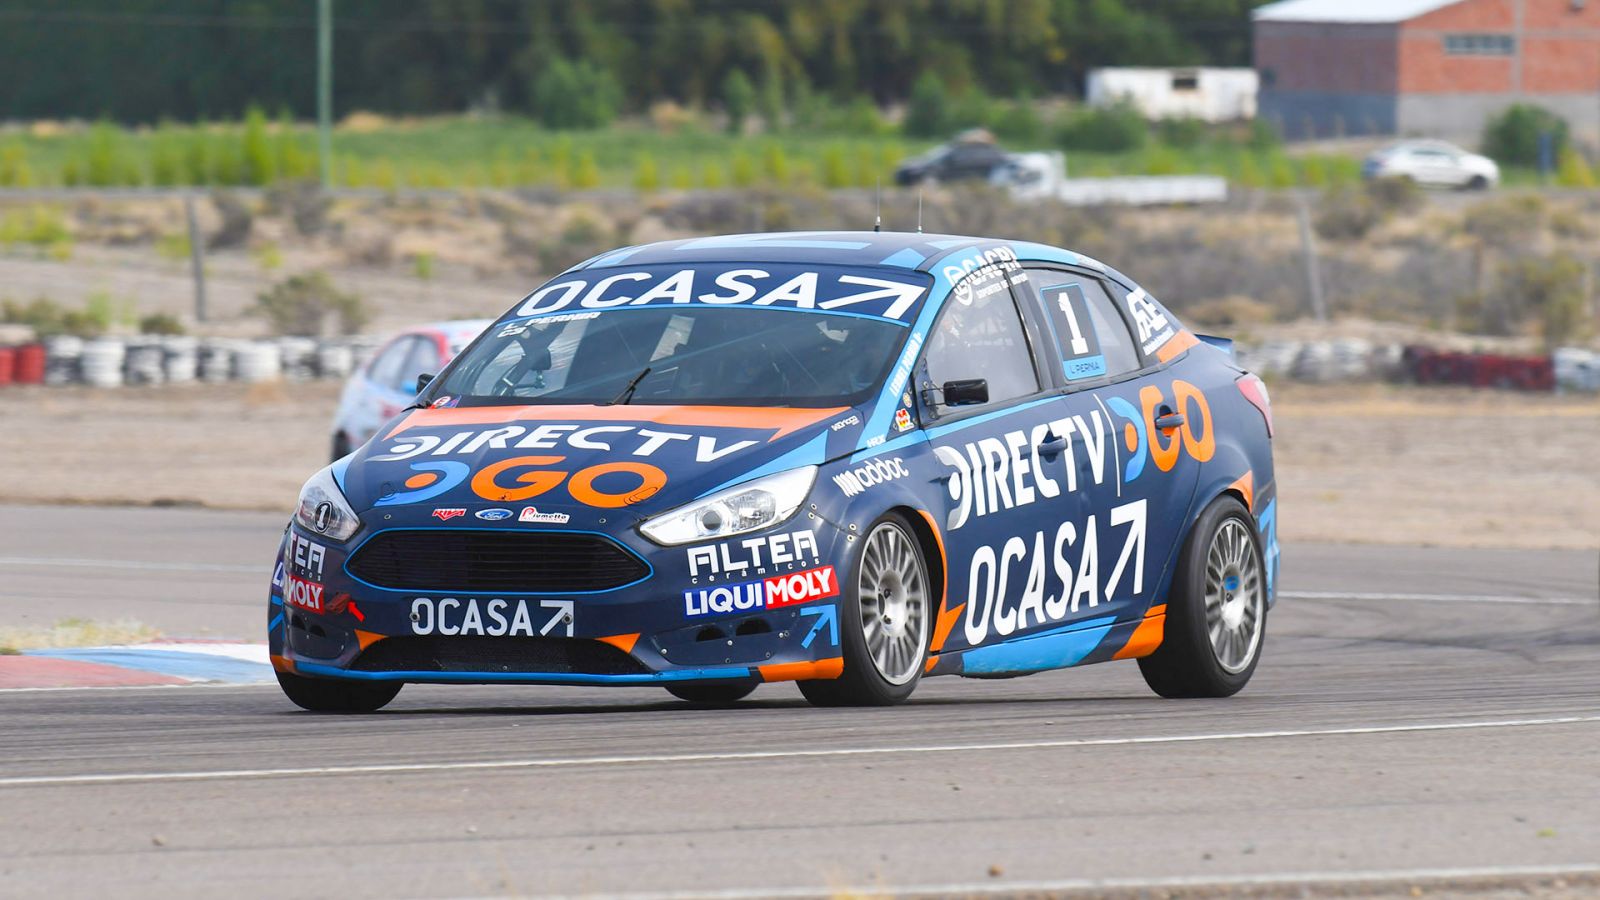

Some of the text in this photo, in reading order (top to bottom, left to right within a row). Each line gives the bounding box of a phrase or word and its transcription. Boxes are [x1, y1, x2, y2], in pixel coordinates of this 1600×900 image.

[517, 269, 818, 316] OCASA
[1058, 292, 1089, 355] 1
[364, 425, 760, 462] DIRECTV
[933, 410, 1105, 531] DIRECTV
[317, 505, 328, 529] 1
[687, 530, 819, 576] ALTEA
[685, 567, 832, 616] LIQUI MOLY
[965, 514, 1099, 645] OCASA
[411, 598, 534, 636] OCASA
